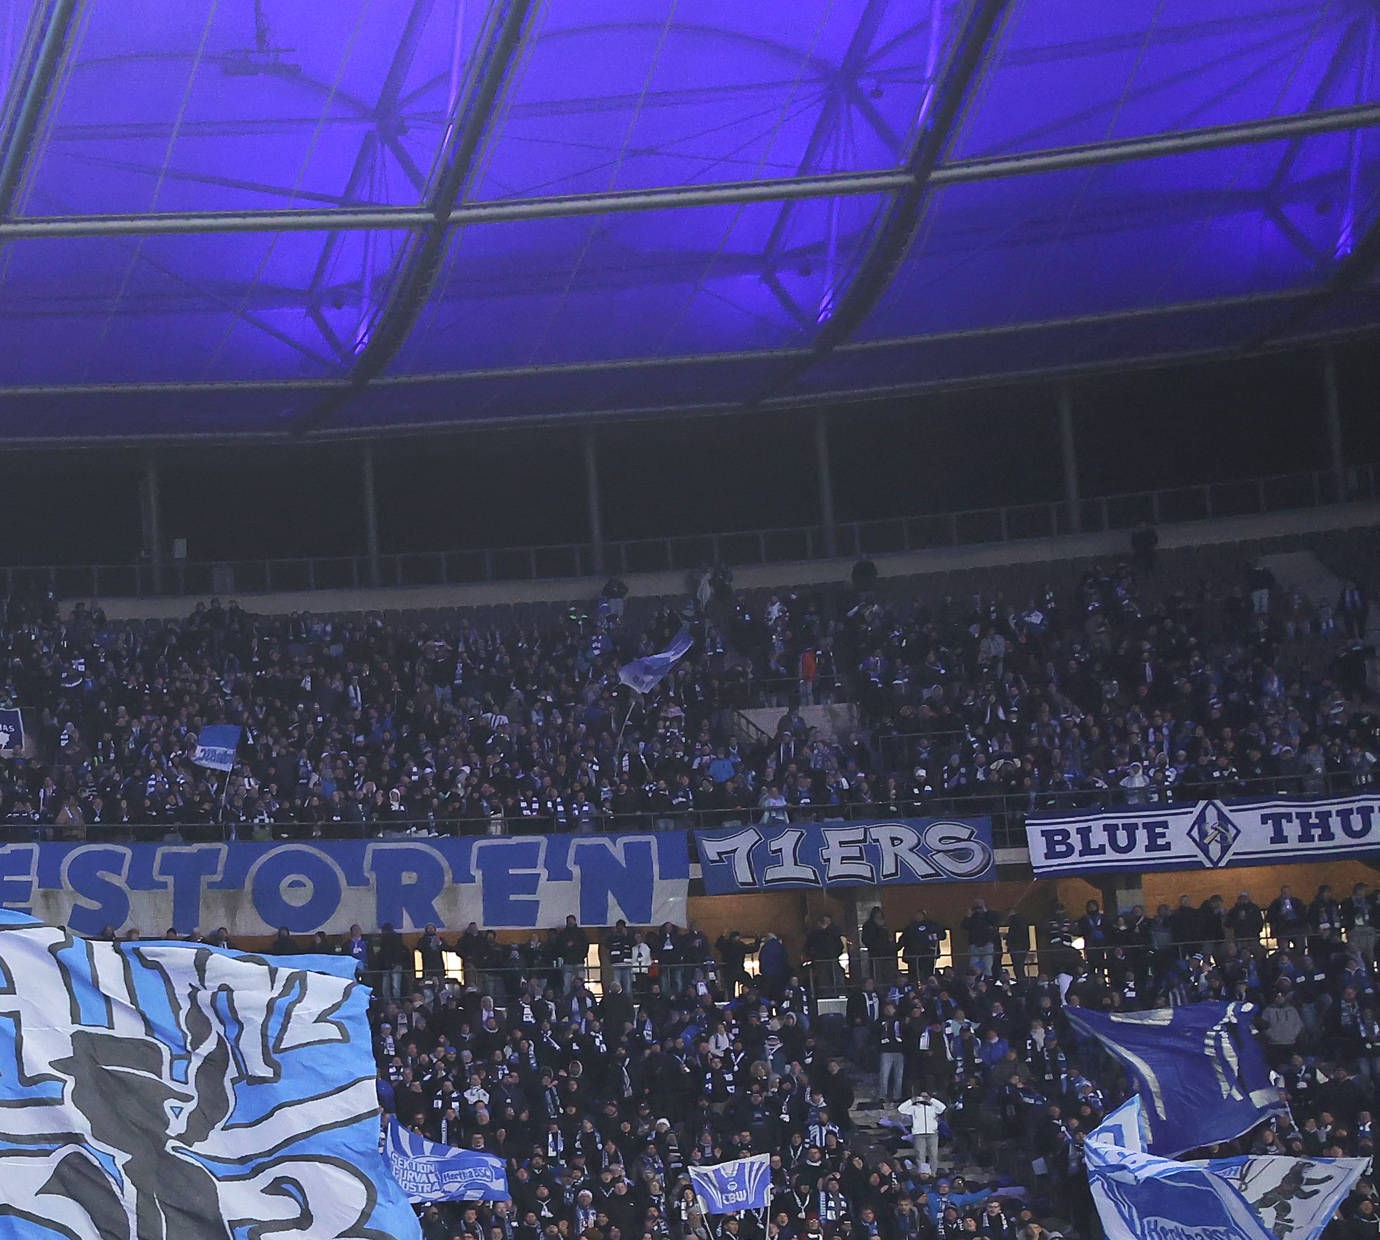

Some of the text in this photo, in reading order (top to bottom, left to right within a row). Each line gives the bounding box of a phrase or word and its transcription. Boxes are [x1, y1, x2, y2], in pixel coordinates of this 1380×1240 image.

[701, 818, 994, 889] 71ERS
[1040, 804, 1380, 860] BLUE THU
[391, 1152, 436, 1173] SEKTION
